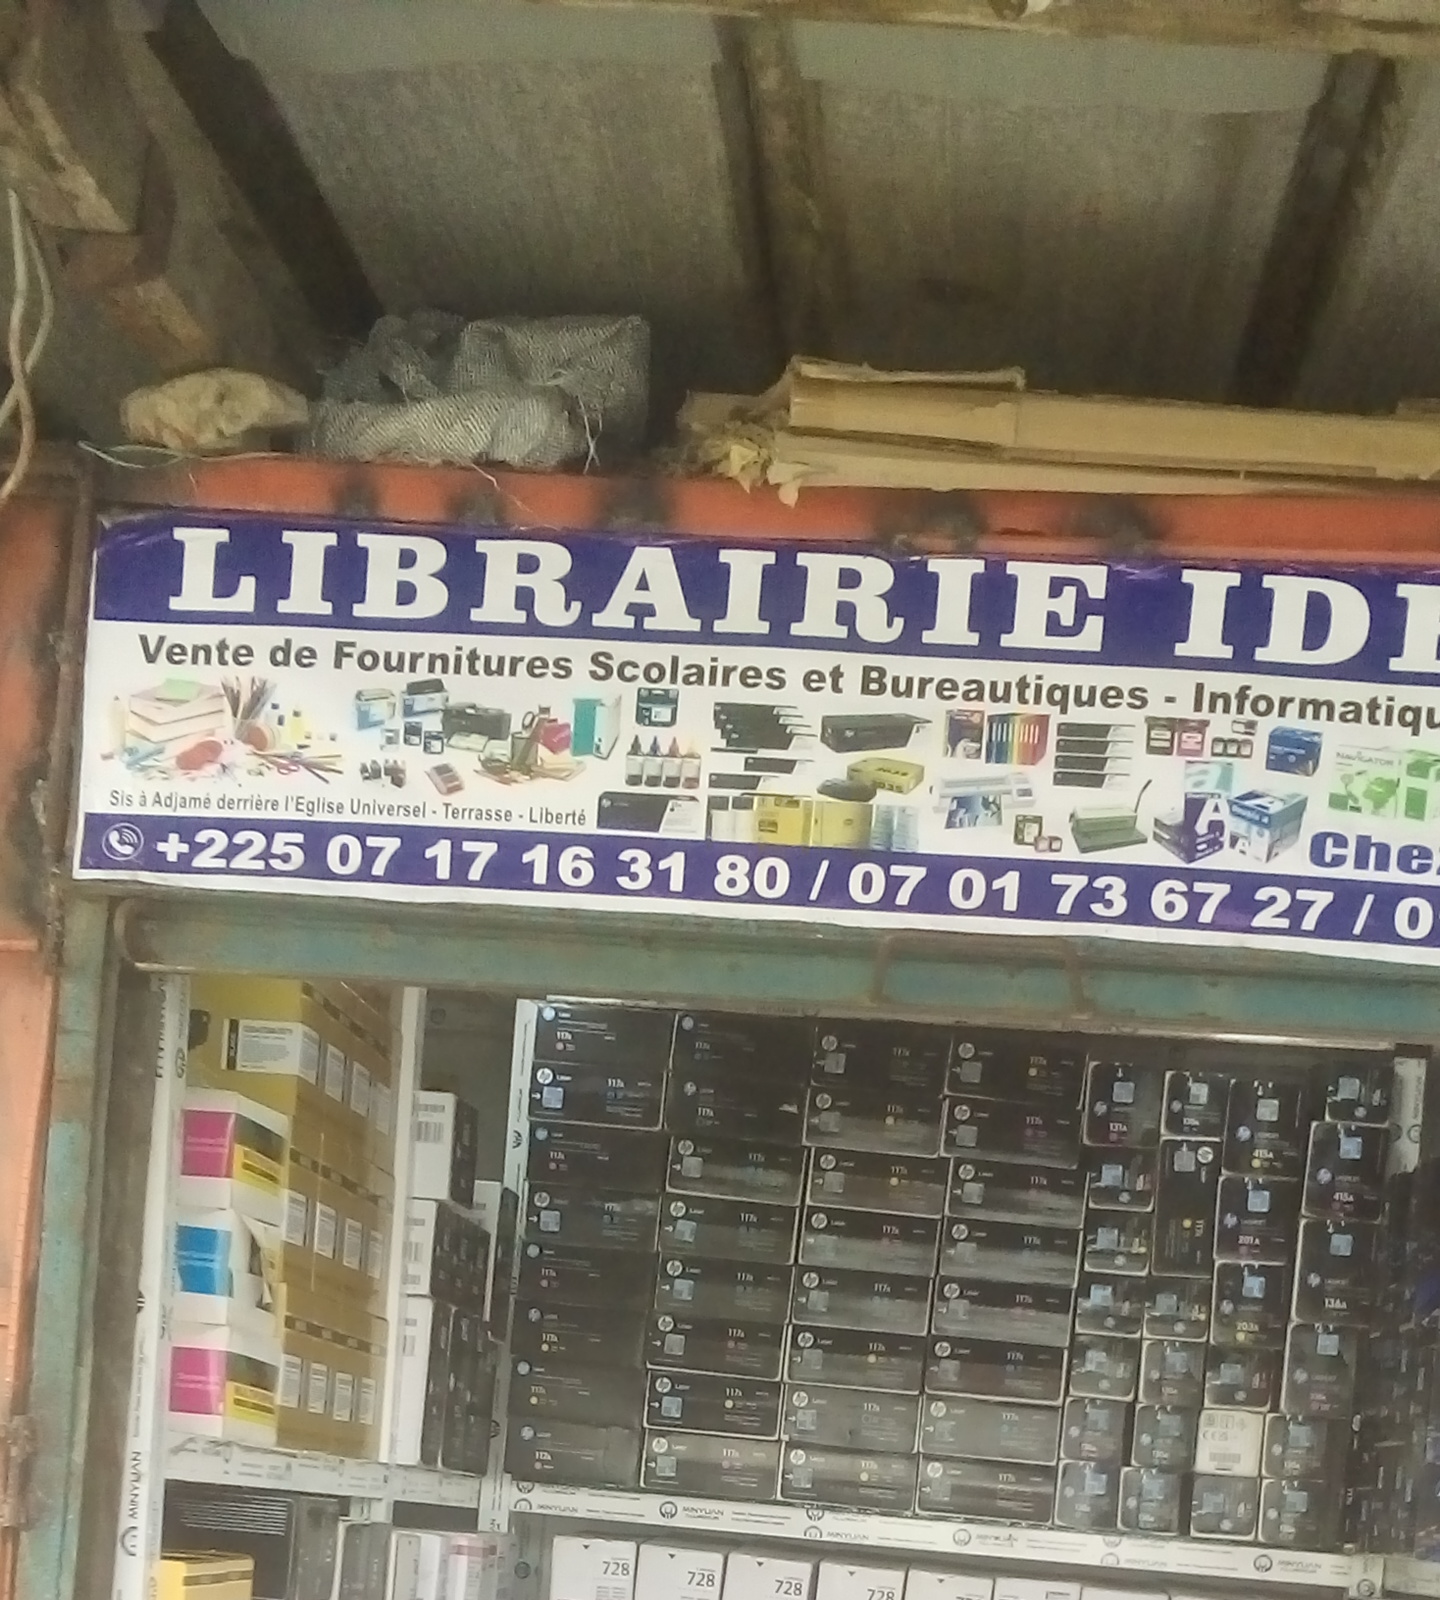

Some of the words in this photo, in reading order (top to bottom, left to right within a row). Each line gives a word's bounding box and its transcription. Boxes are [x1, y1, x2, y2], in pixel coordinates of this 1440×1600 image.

[168, 526, 1108, 653] LIBRAIRIE
[138, 634, 255, 667] Vente
[269, 638, 318, 669] de
[333, 640, 574, 680] Fournitures
[588, 651, 787, 690] Scolaires
[802, 664, 845, 694] et
[860, 664, 1149, 715] Bureautiques
[1164, 696, 1178, 704] -
[110, 790, 134, 808] Sis
[138, 791, 148, 808] à
[152, 791, 211, 813] Adjamé
[216, 792, 279, 812] derrière
[284, 795, 345, 816] l'Eglise
[350, 797, 427, 819] Universel
[443, 802, 513, 823] Terrasse
[529, 806, 587, 826] Liberté
[1309, 831, 1440, 875] Che
[156, 829, 306, 872] +225
[326, 834, 402, 877] 07
[424, 838, 499, 882] 17
[522, 843, 595, 888] 16
[616, 847, 686, 893] 31
[713, 853, 791, 899] 80
[808, 859, 830, 902] /
[848, 862, 927, 907] 07
[949, 868, 1021, 913] 01
[1050, 874, 1128, 918] 73
[1150, 879, 1231, 925] 67
[1250, 886, 1334, 932] 27
[1352, 893, 1375, 937] /
[1394, 897, 1440, 940] 0
[128, 1450, 142, 1520] MINYUAN
[602, 1560, 630, 1577] 728
[687, 1570, 716, 1588] 728
[775, 1579, 803, 1597] 728
